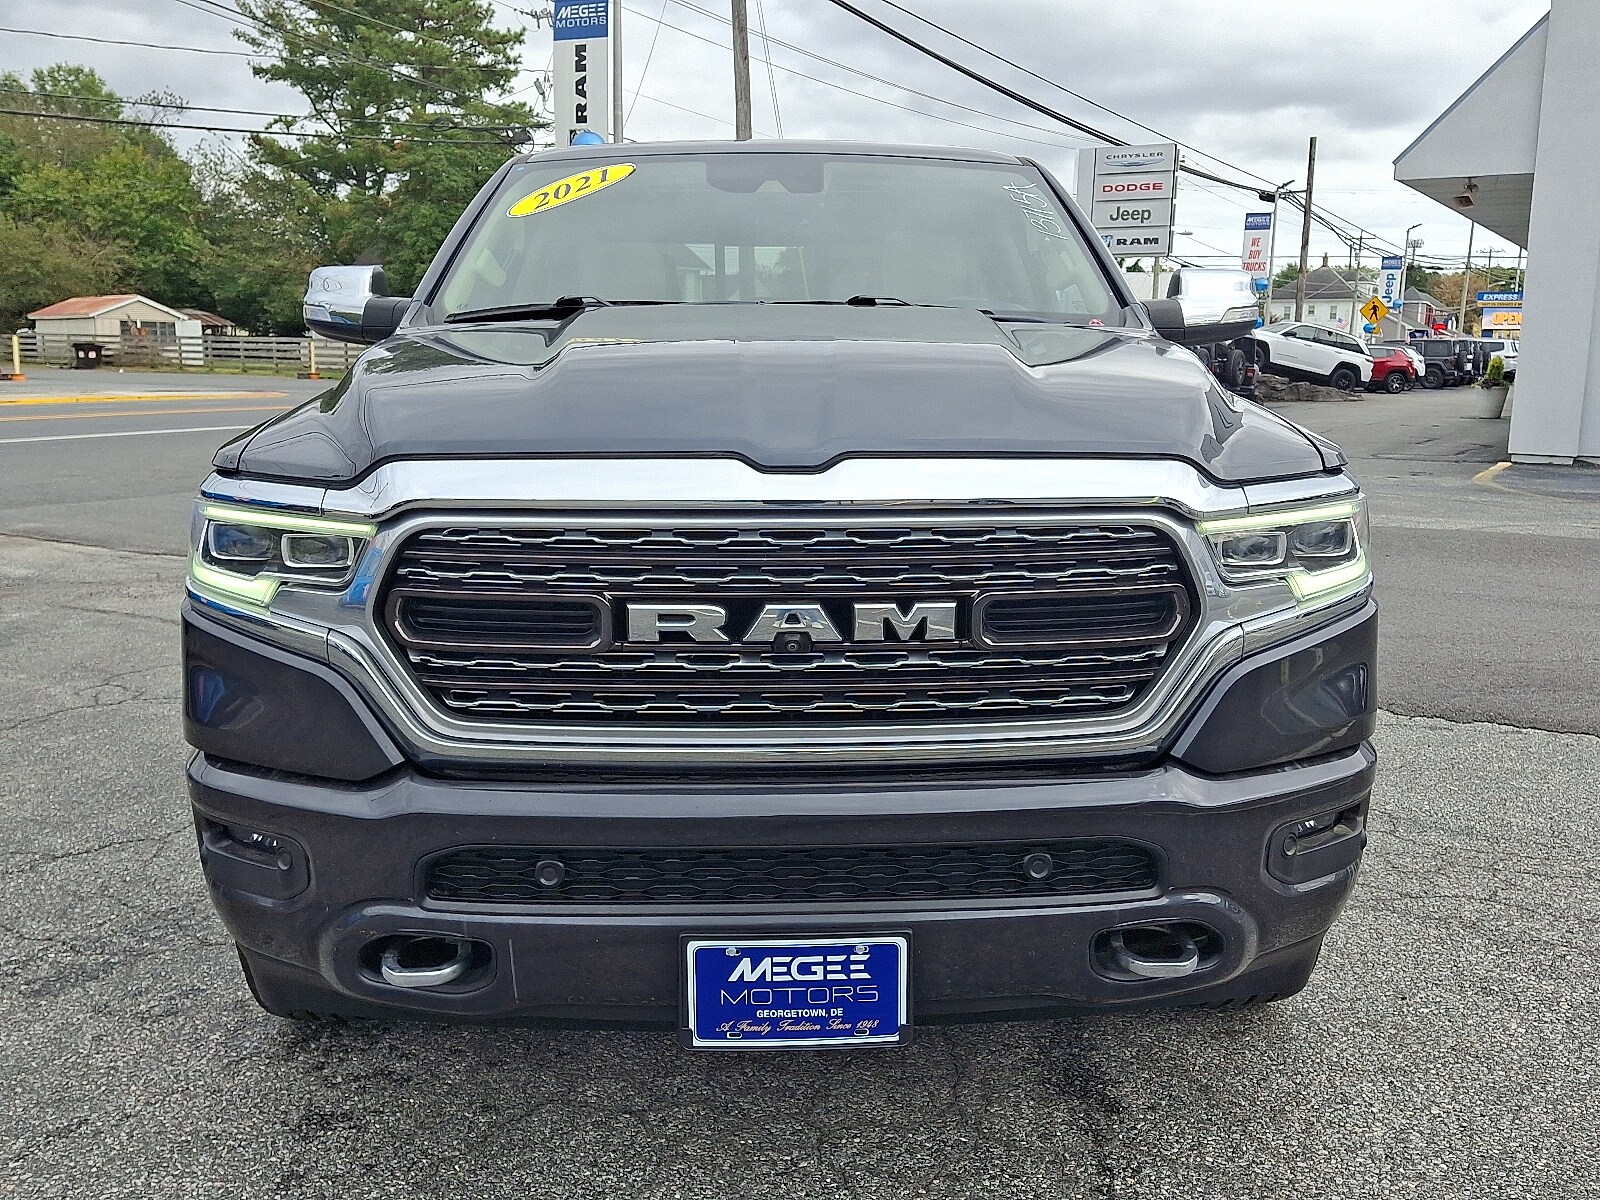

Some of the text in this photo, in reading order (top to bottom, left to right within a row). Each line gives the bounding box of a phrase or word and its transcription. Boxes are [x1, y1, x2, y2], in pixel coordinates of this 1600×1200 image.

[556, 3, 607, 19] MEGEE
[555, 16, 607, 28] MOTORS
[575, 43, 588, 124] RAM
[1106, 151, 1164, 160] CHRYSLER
[533, 168, 609, 211] 2021
[1102, 182, 1164, 193] DODGE
[1109, 206, 1152, 224] Jeep
[1116, 237, 1160, 246] RAM
[1251, 237, 1262, 247] WE
[1248, 249, 1263, 260] BUY
[1243, 261, 1267, 272] TRUCKS
[1382, 273, 1397, 303] Jeep
[1482, 293, 1519, 301] EXPRESS
[626, 602, 957, 642] RAM
[727, 954, 872, 982] MEGEE
[720, 985, 879, 1005] MOTORS
[756, 1007, 844, 1019] GEORGETOWN, DE
[715, 1017, 881, 1036] A Family Tradition Since 1948
